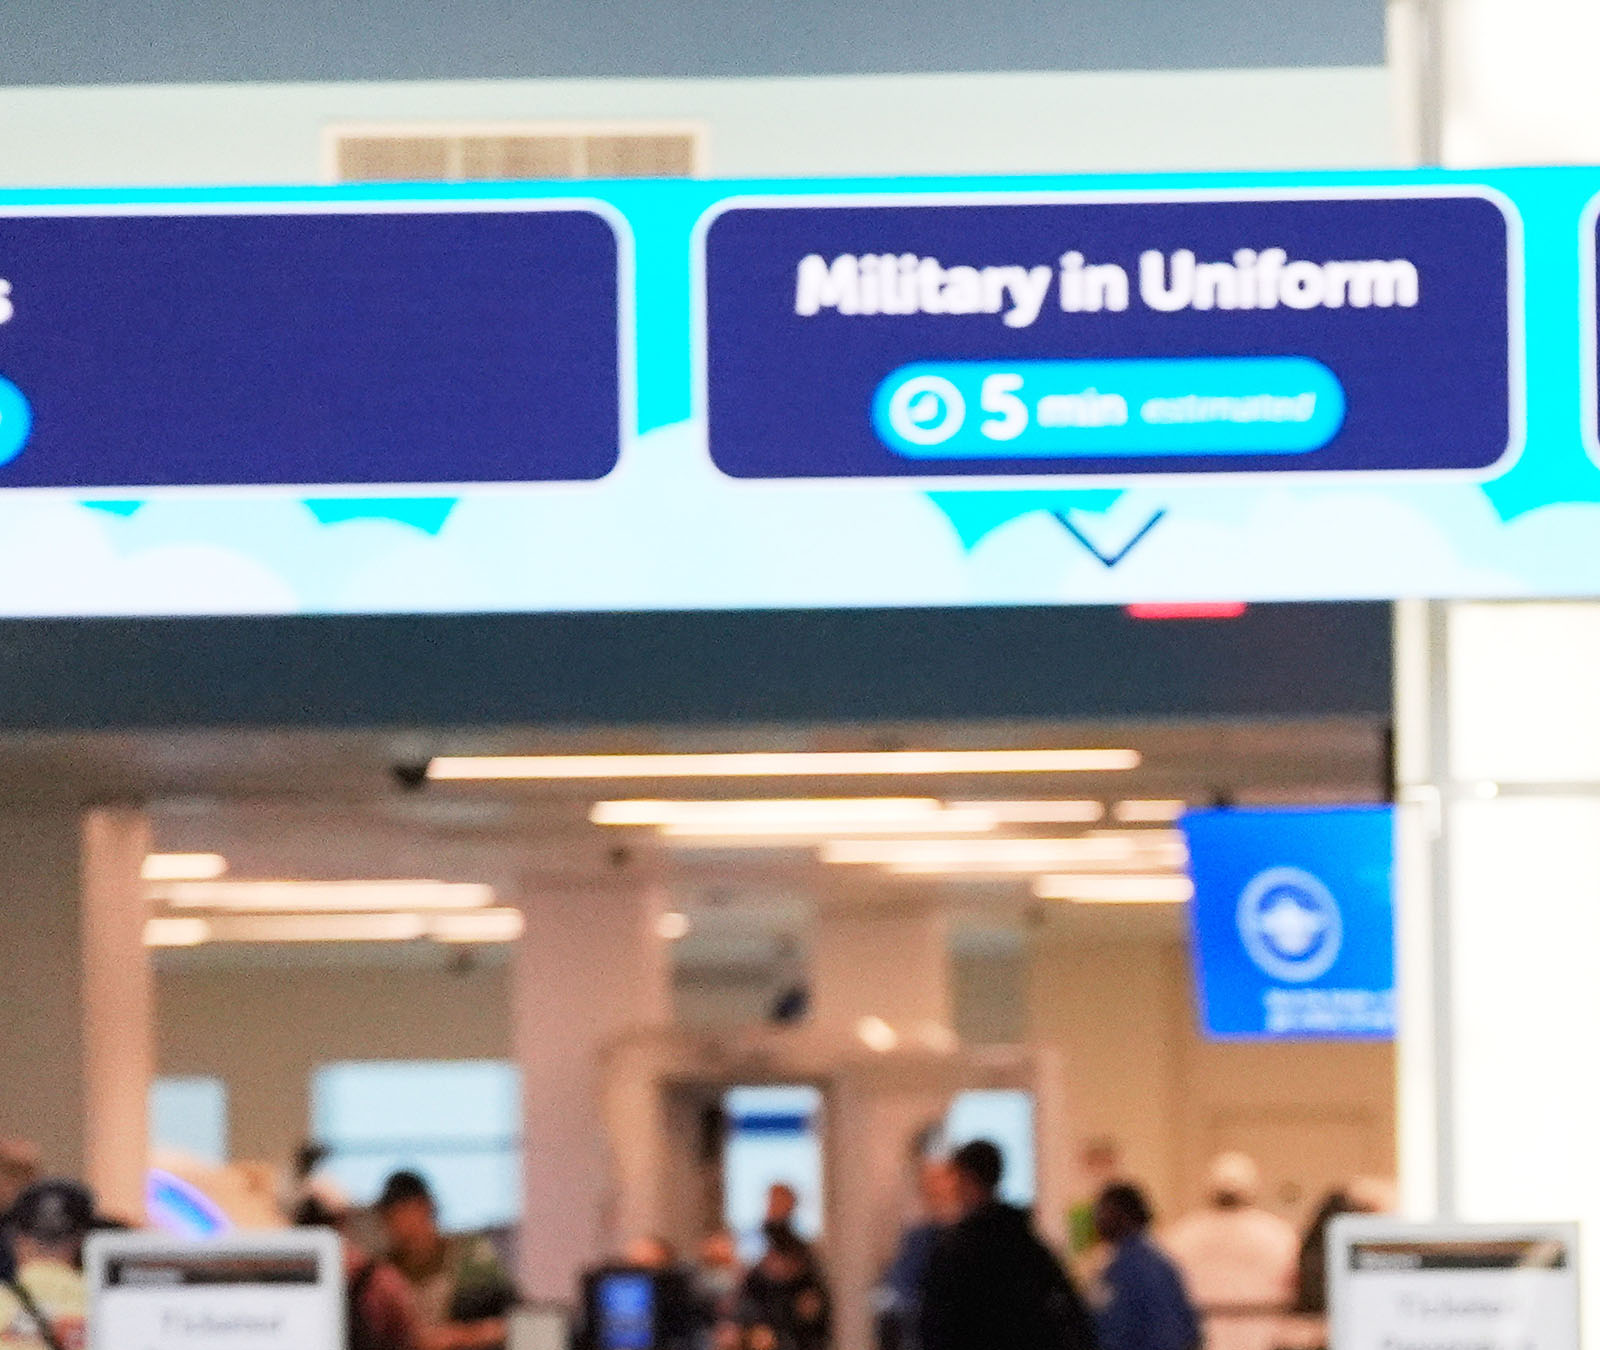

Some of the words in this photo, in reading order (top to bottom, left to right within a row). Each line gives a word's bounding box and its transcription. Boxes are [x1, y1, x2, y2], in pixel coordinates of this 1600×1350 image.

[795, 253, 1053, 328] Military
[1060, 251, 1129, 313] in
[1139, 247, 1419, 312] Uniform
[981, 373, 1029, 441] 5
[1037, 388, 1129, 427] min
[1140, 392, 1317, 424] estimated
